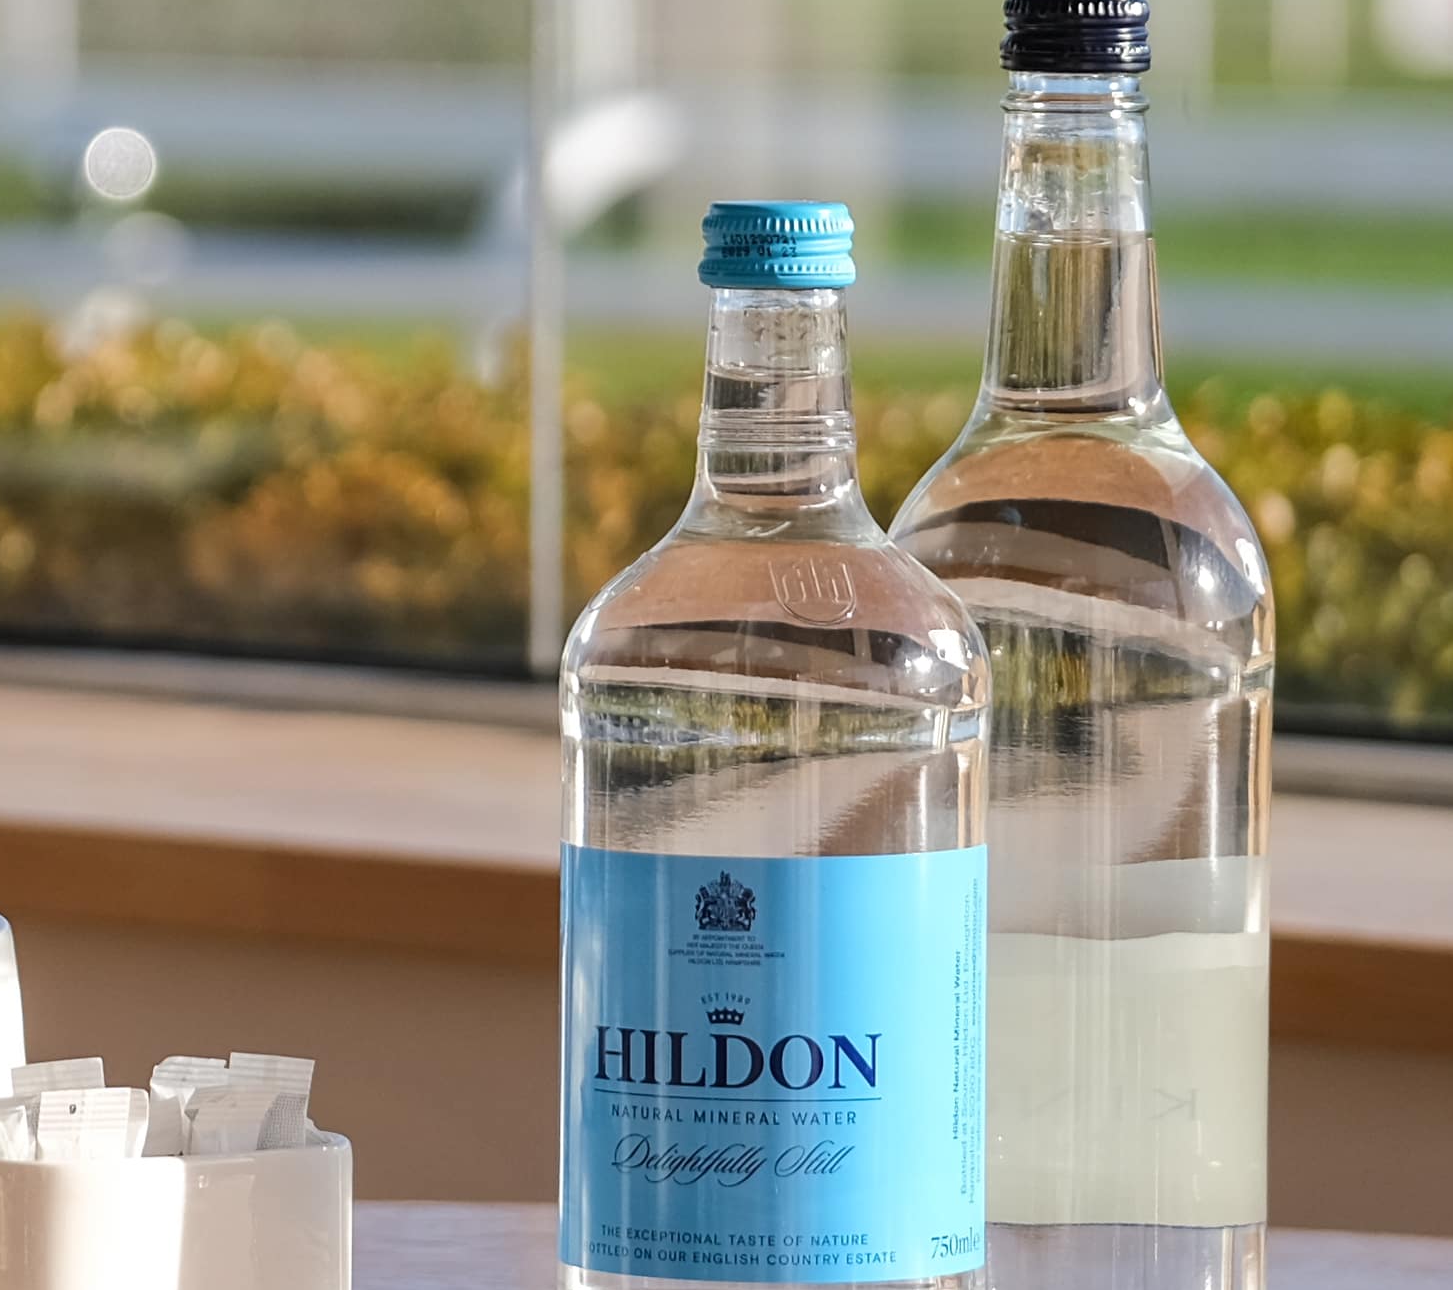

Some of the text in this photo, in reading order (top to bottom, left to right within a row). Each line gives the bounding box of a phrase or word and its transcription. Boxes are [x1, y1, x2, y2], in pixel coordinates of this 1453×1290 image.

[700, 991, 720, 1005] EST
[593, 1024, 884, 1091] HILDON
[611, 1103, 857, 1126] NATURAL MINERAL WATER
[611, 1133, 856, 1188] Delightfully Still
[601, 1224, 869, 1247] THE EXCEPTIONAL TASTE OF NATURE
[584, 1241, 897, 1266] OTTLED ON OUR ENGLISH COUNTRY ESTATE
